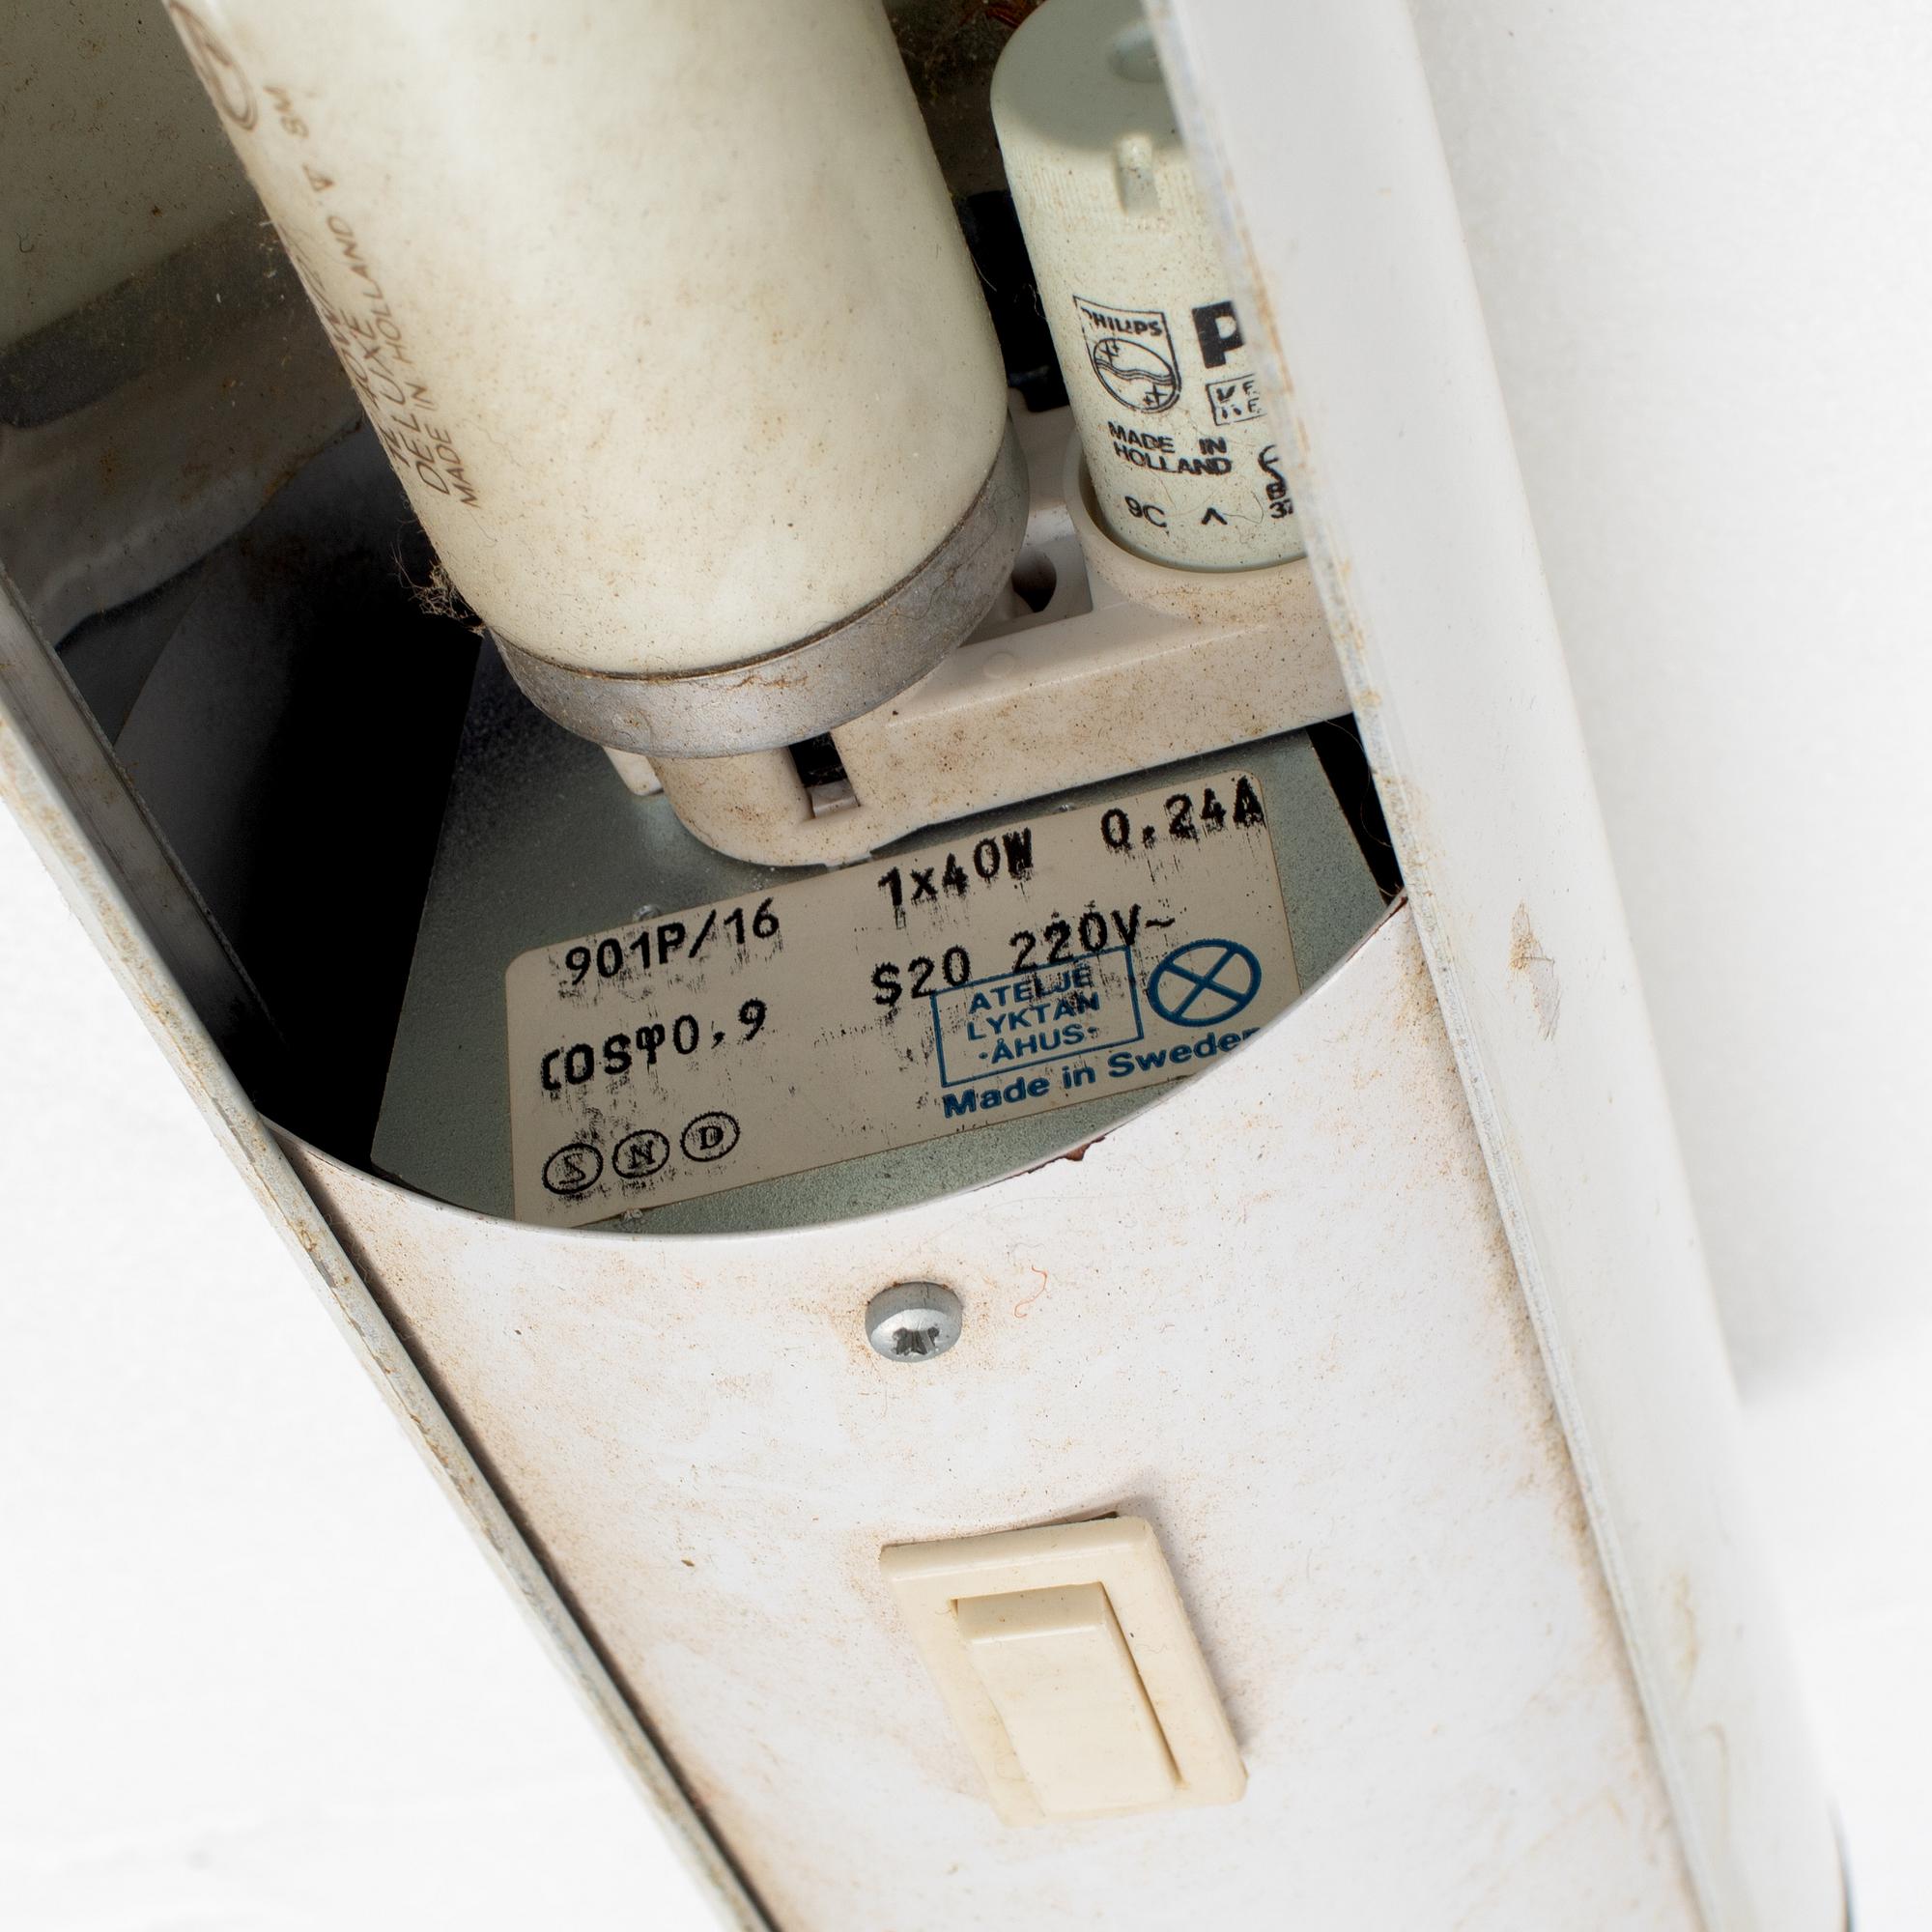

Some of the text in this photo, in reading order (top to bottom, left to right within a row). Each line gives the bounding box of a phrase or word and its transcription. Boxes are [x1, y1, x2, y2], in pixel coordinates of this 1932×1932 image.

[327, 215, 412, 364] HOLLAND
[404, 381, 439, 412] IN
[1107, 421, 1228, 456] MADE IN
[1113, 441, 1233, 476] HOLLAND
[424, 423, 480, 508] MADE
[1124, 496, 1167, 527] 9C
[565, 896, 780, 986] 901P/16
[872, 945, 971, 1007] S20
[969, 964, 1093, 1014] ATELJE
[967, 992, 1100, 1041] LYKTAN
[942, 1073, 1050, 1119] Made
[1062, 1065, 1096, 1090] in
